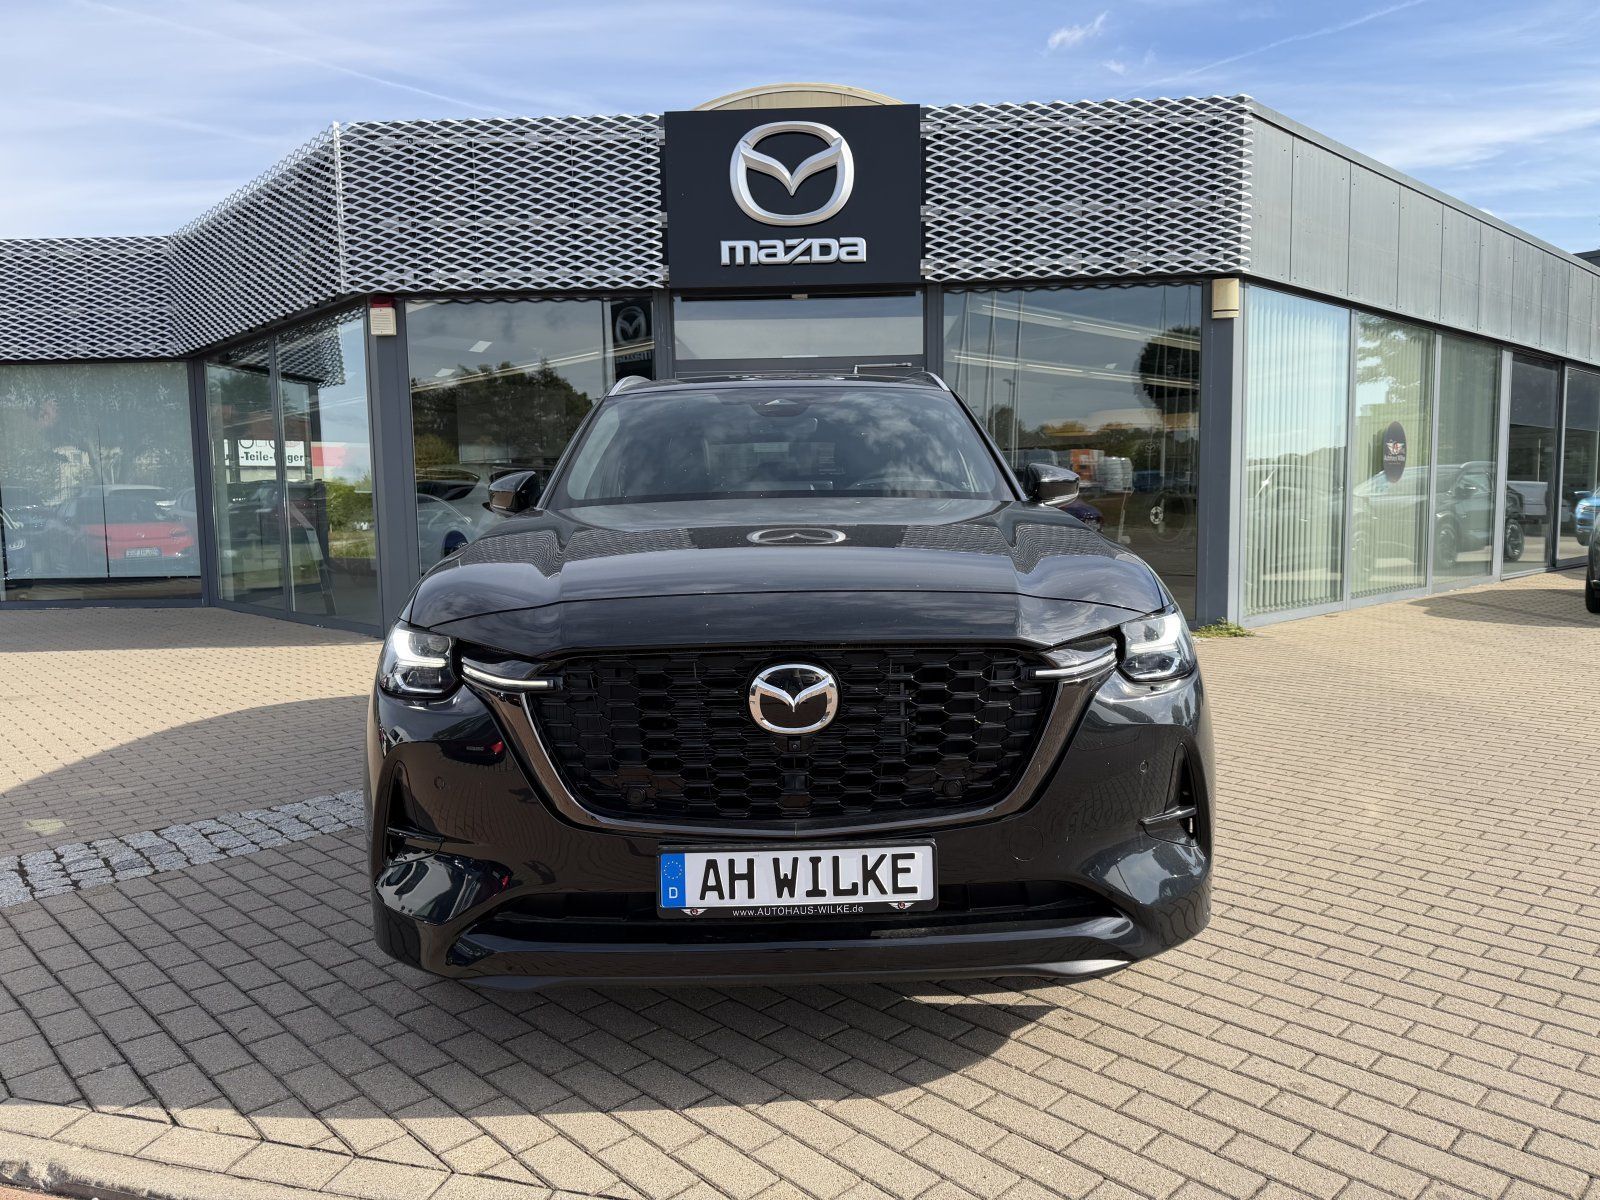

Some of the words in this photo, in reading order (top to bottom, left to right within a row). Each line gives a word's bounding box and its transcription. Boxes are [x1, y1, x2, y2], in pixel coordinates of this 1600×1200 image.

[720, 237, 867, 266] mazda
[700, 858, 755, 901] AH
[772, 852, 919, 899] WILKE
[668, 886, 678, 899] D
[732, 904, 864, 917] www.AUTOHAUS-WILKE.de
